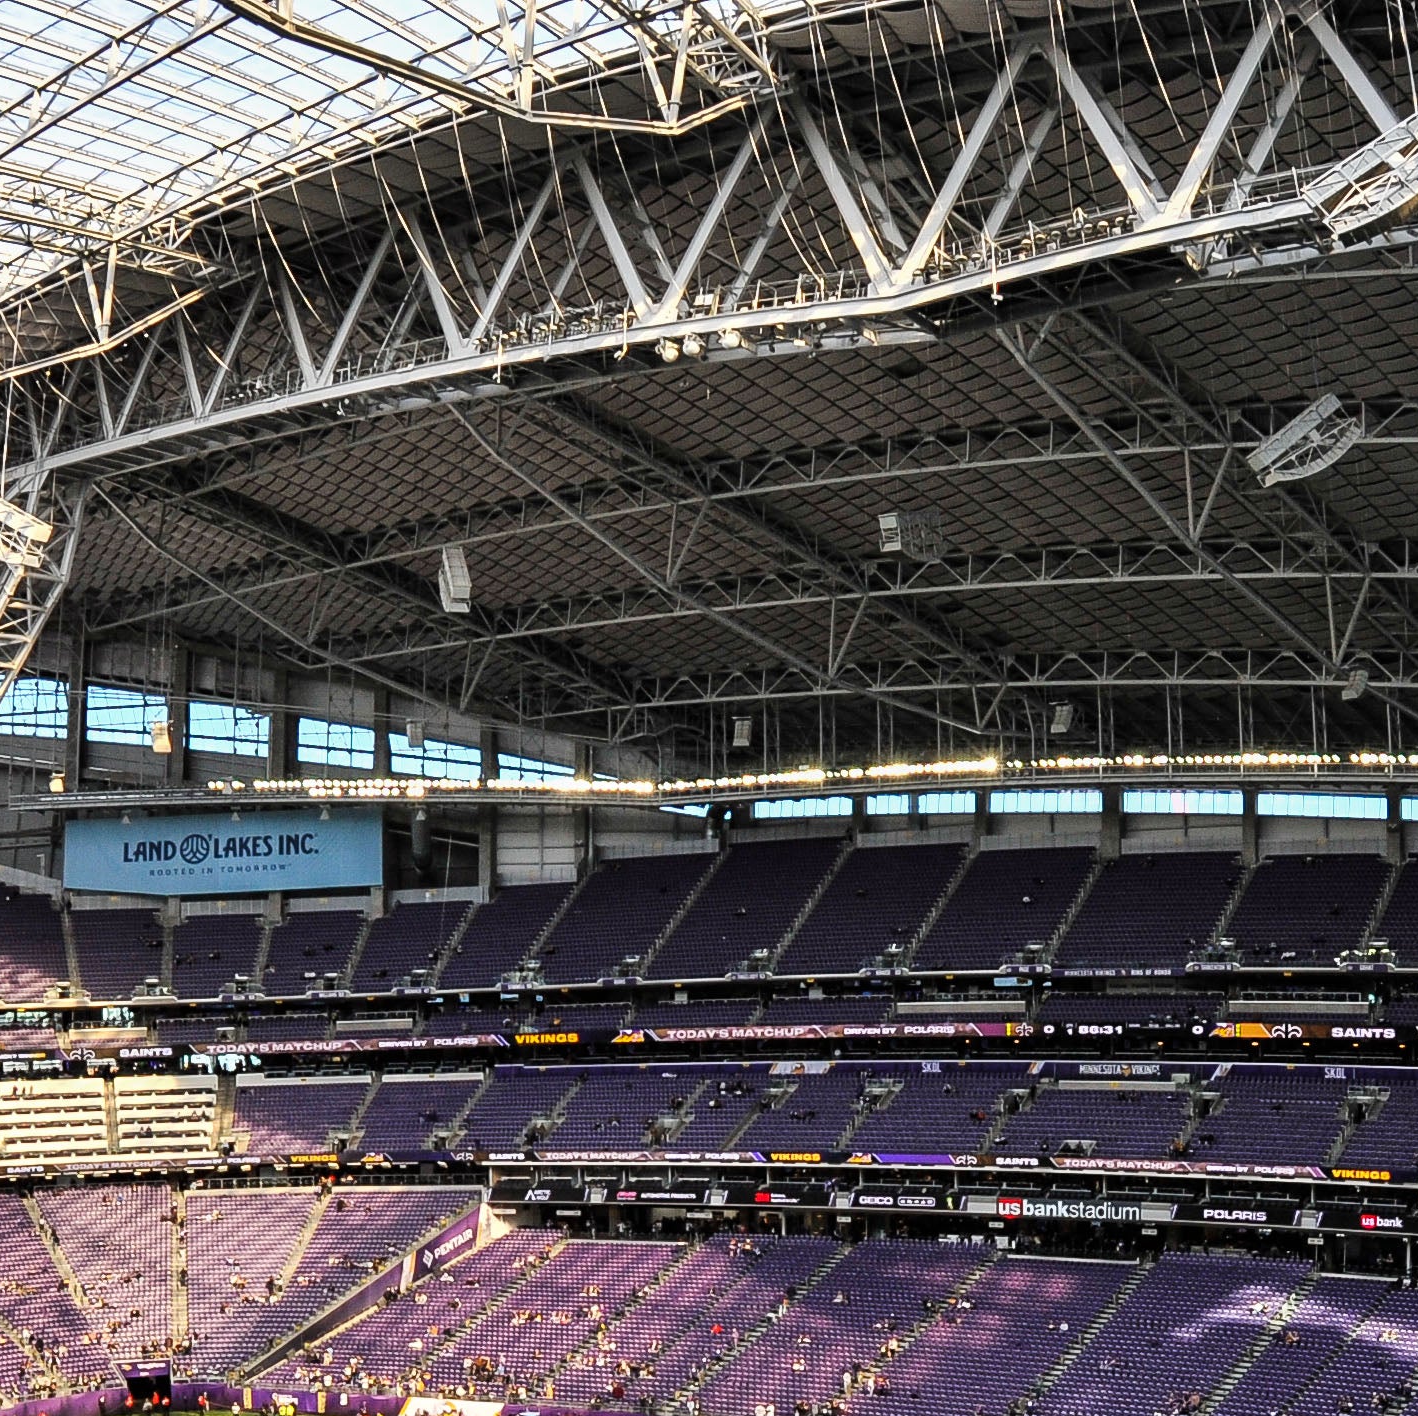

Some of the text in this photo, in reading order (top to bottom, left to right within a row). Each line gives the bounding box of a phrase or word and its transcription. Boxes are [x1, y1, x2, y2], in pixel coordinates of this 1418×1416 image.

[123, 841, 177, 863] LAND
[278, 832, 319, 855] INC.
[149, 868, 195, 877] ROOTED
[201, 867, 214, 875] IN
[667, 1027, 804, 1040] TODAY'S MATCHUP
[843, 1025, 955, 1035] DRIVEN BY POLARIS
[1043, 1025, 1055, 1034] 0
[1078, 1025, 1123, 1035] 86:31
[1192, 1025, 1204, 1035] 0
[1331, 1027, 1396, 1038] SAINTS
[379, 1037, 479, 1048] DRIVEN BY POLARIS
[515, 1033, 579, 1045] VIKINGS
[120, 1047, 173, 1058] SAINTS
[207, 1041, 342, 1053] TODAY'S MATCHUP
[1079, 1065, 1161, 1076] MINNESOTA VIKINGS
[1324, 1067, 1346, 1079] SKOL
[290, 1154, 338, 1163] VIKINGS
[588, 1151, 640, 1160] MATCHUP
[770, 1153, 821, 1162] VIKINGS
[66, 1160, 162, 1172] TODAY'S MATCHUP
[995, 1157, 1039, 1166] SAINTS
[1064, 1158, 1175, 1170] TODAY'S MATCHUP
[7, 1165, 44, 1174] SAINTS
[1331, 1169, 1391, 1181] VIKINGS
[1204, 1209, 1267, 1221] POLARIS
[1376, 1215, 1403, 1228] bank
[434, 1228, 474, 1260] PENTAIR
